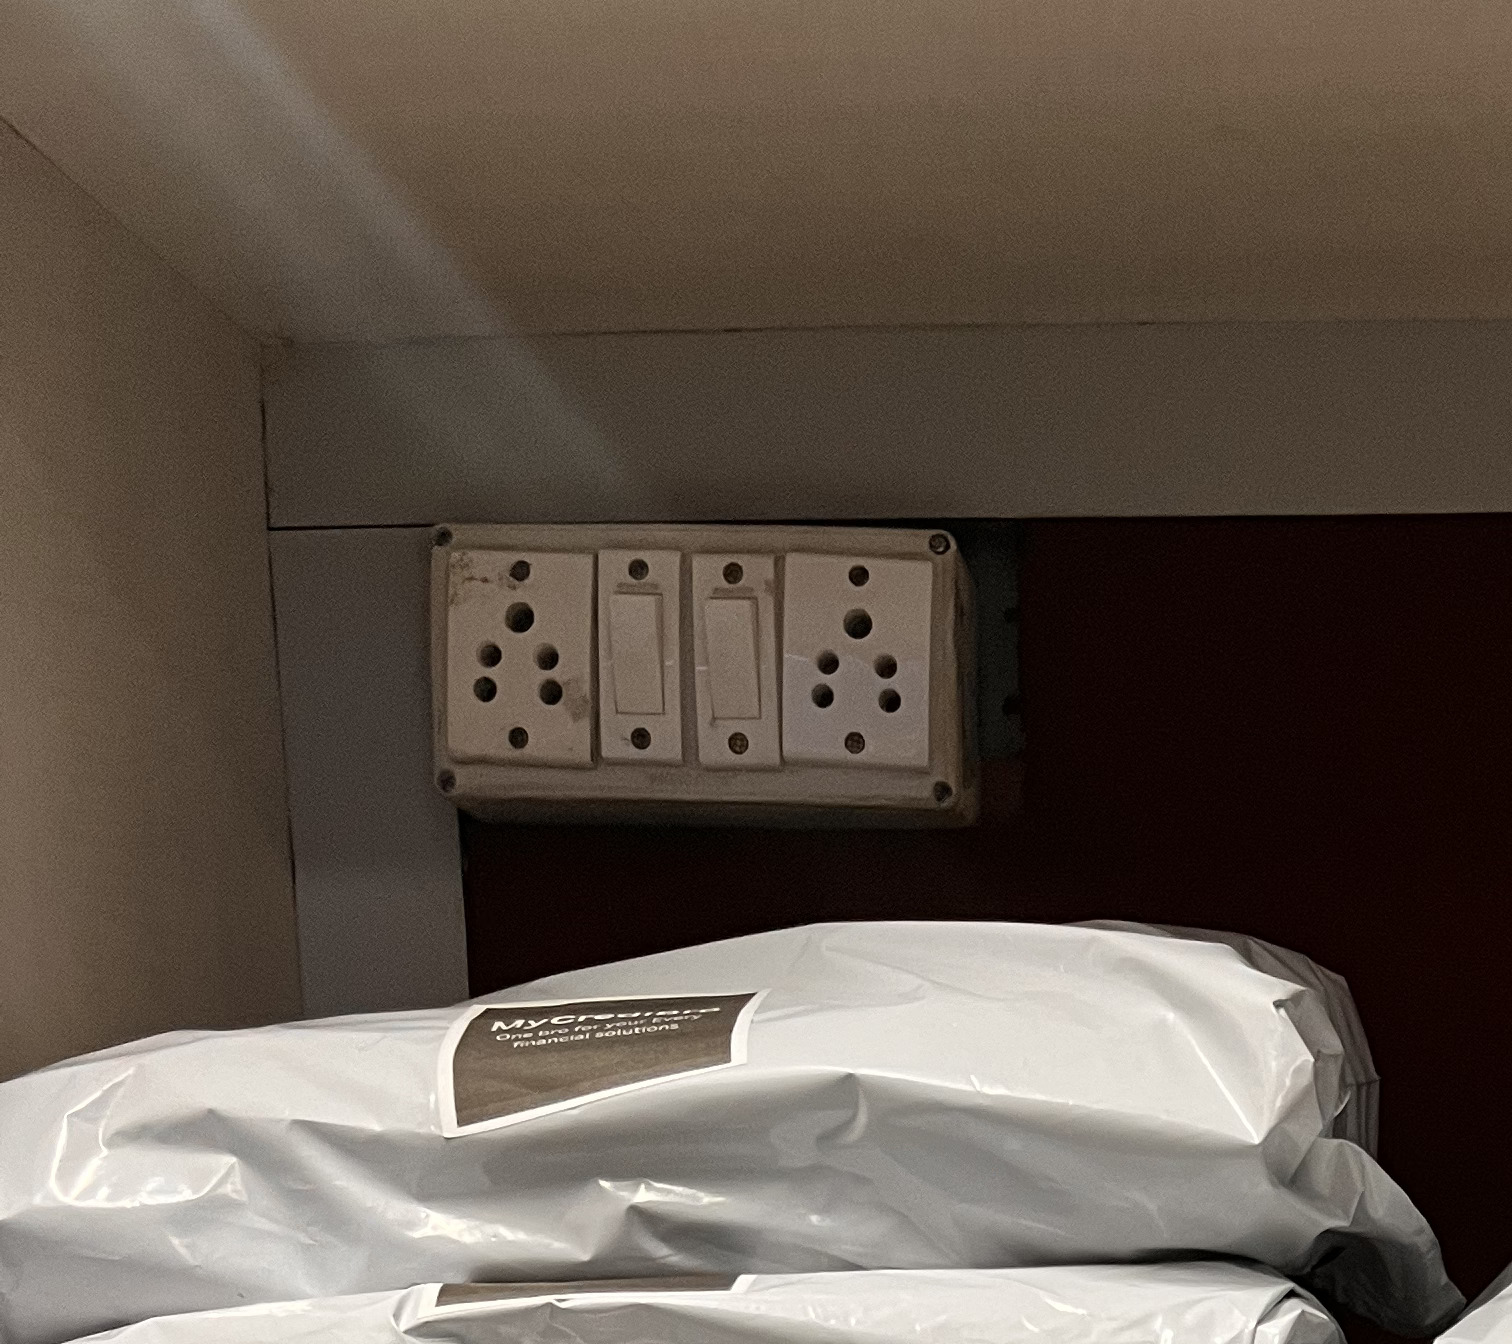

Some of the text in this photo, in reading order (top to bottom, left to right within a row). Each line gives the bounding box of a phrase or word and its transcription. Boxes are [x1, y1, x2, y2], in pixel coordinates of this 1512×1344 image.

[495, 1031, 534, 1041] One
[538, 1026, 570, 1037] bro
[574, 1024, 599, 1032] for
[651, 1013, 703, 1024] Every
[512, 1023, 680, 1048] financial solutions
